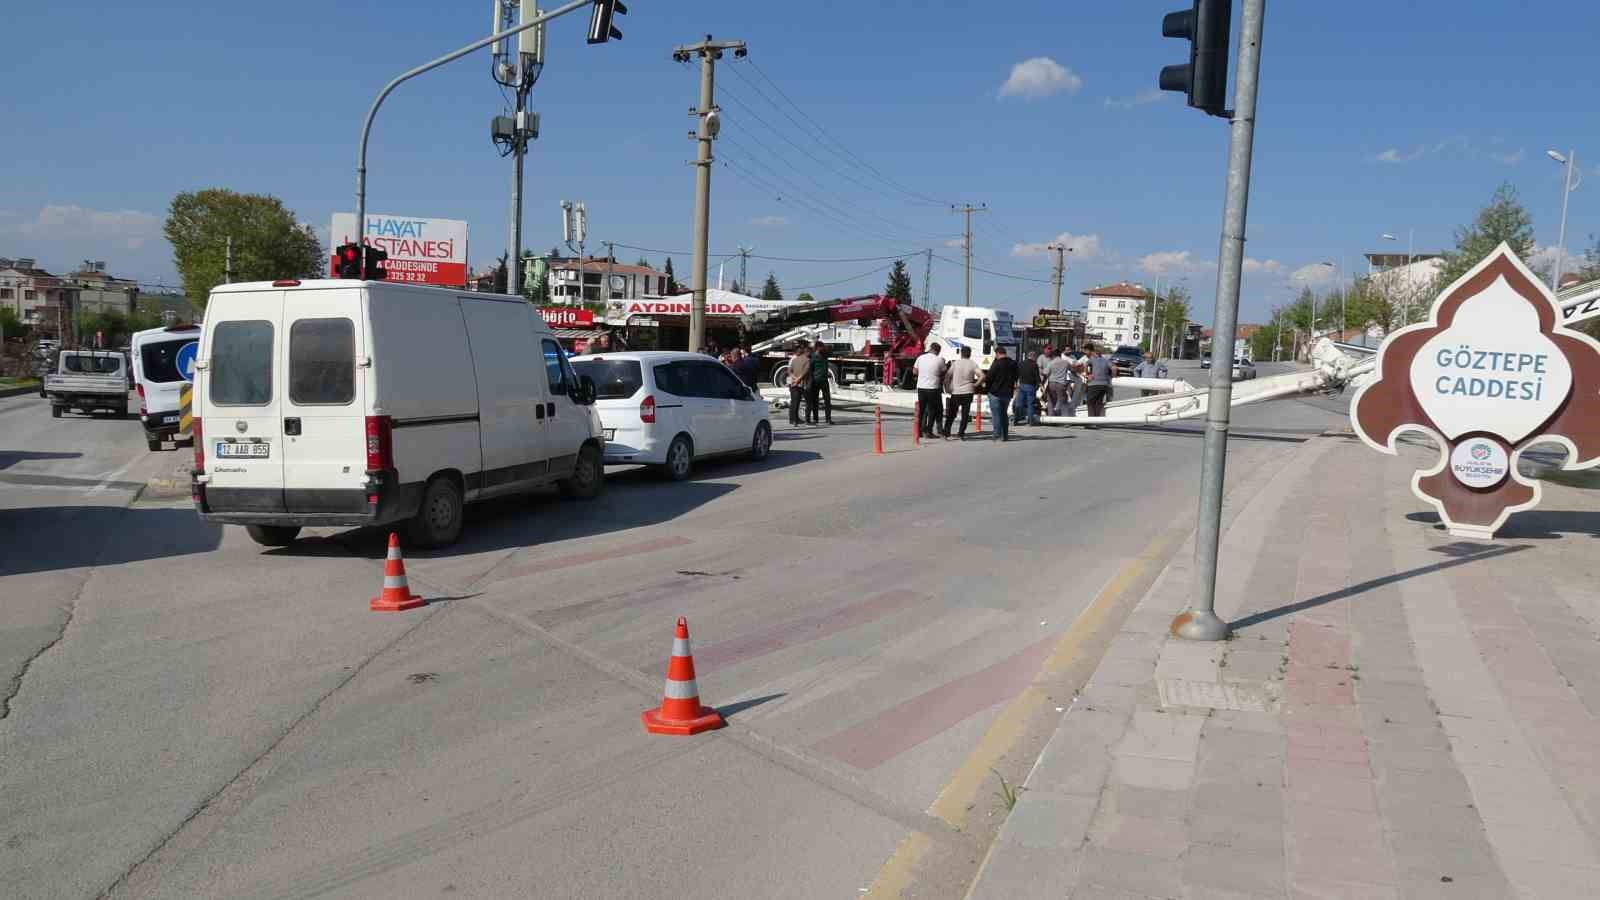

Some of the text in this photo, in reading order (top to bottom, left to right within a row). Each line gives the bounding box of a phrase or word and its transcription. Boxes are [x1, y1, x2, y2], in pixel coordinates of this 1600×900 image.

[367, 218, 427, 238] HAYAT
[629, 303, 690, 313] AYDIN
[1437, 344, 1548, 374] GÖZTEPE
[1435, 375, 1542, 401] CADDESİ
